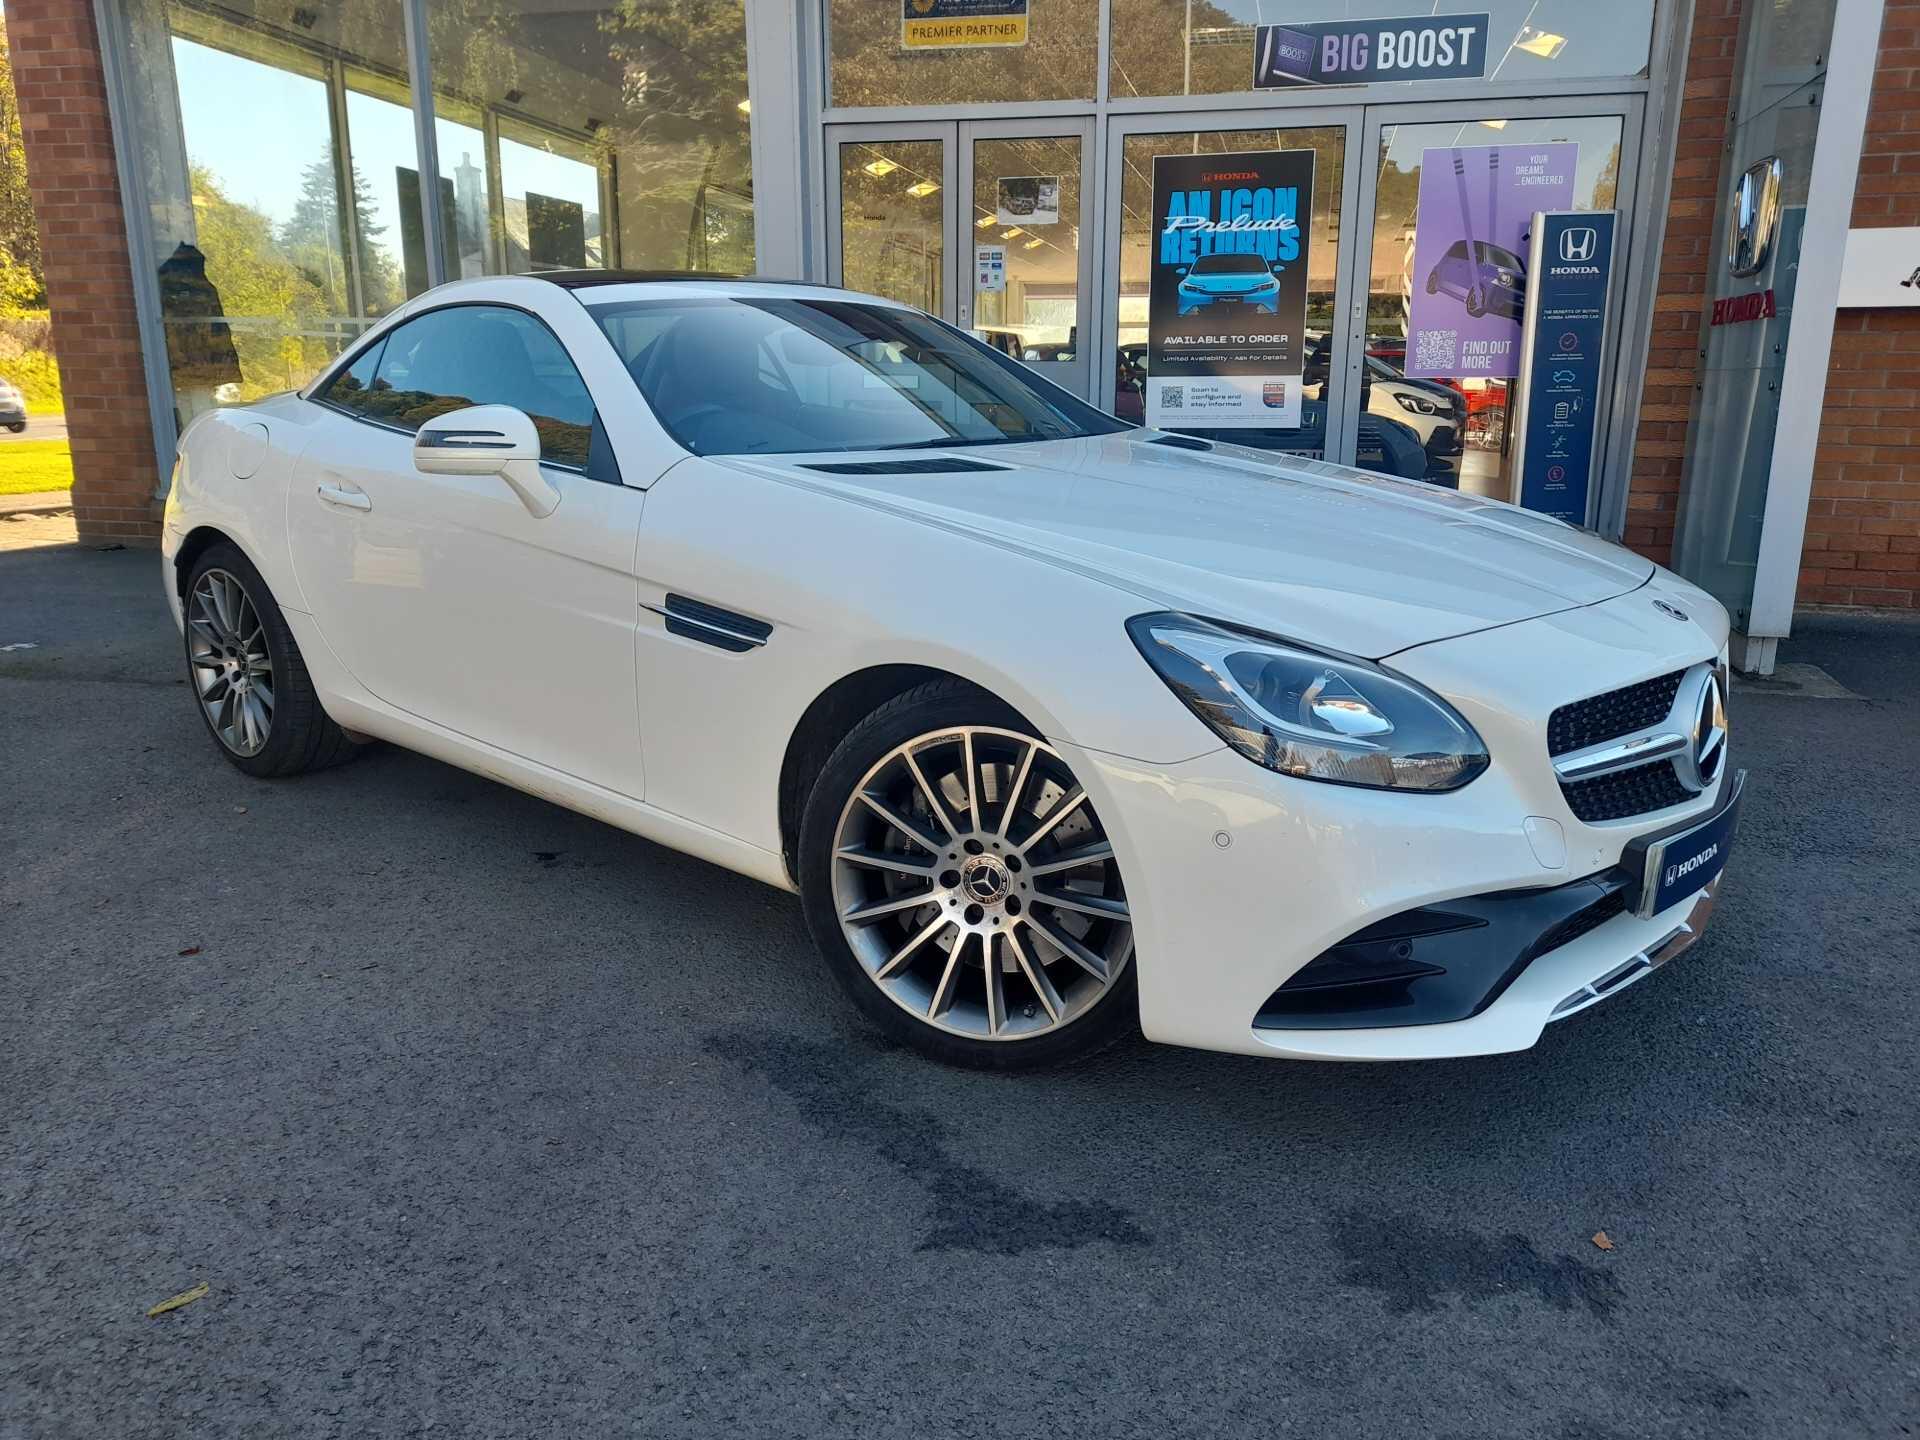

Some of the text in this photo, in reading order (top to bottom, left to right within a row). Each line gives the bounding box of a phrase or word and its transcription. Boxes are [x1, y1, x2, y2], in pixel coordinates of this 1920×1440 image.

[912, 23, 1017, 39] PREMIER PARTNER
[1321, 27, 1476, 73] BIG BOOST
[1530, 154, 1548, 164] YOUR
[1214, 172, 1260, 181] HONDA
[1515, 165, 1544, 175] DREAMS
[1167, 187, 1298, 228] AN ICON
[1164, 213, 1297, 234] Prelude
[1550, 266, 1600, 275] HONDA
[1710, 288, 1777, 326] HONDA
[1163, 334, 1288, 345] AVAILABLE TO ORDER
[1462, 340, 1512, 354] FIND OUT
[1461, 355, 1492, 369] MORE
[1677, 842, 1718, 879] HONDA
